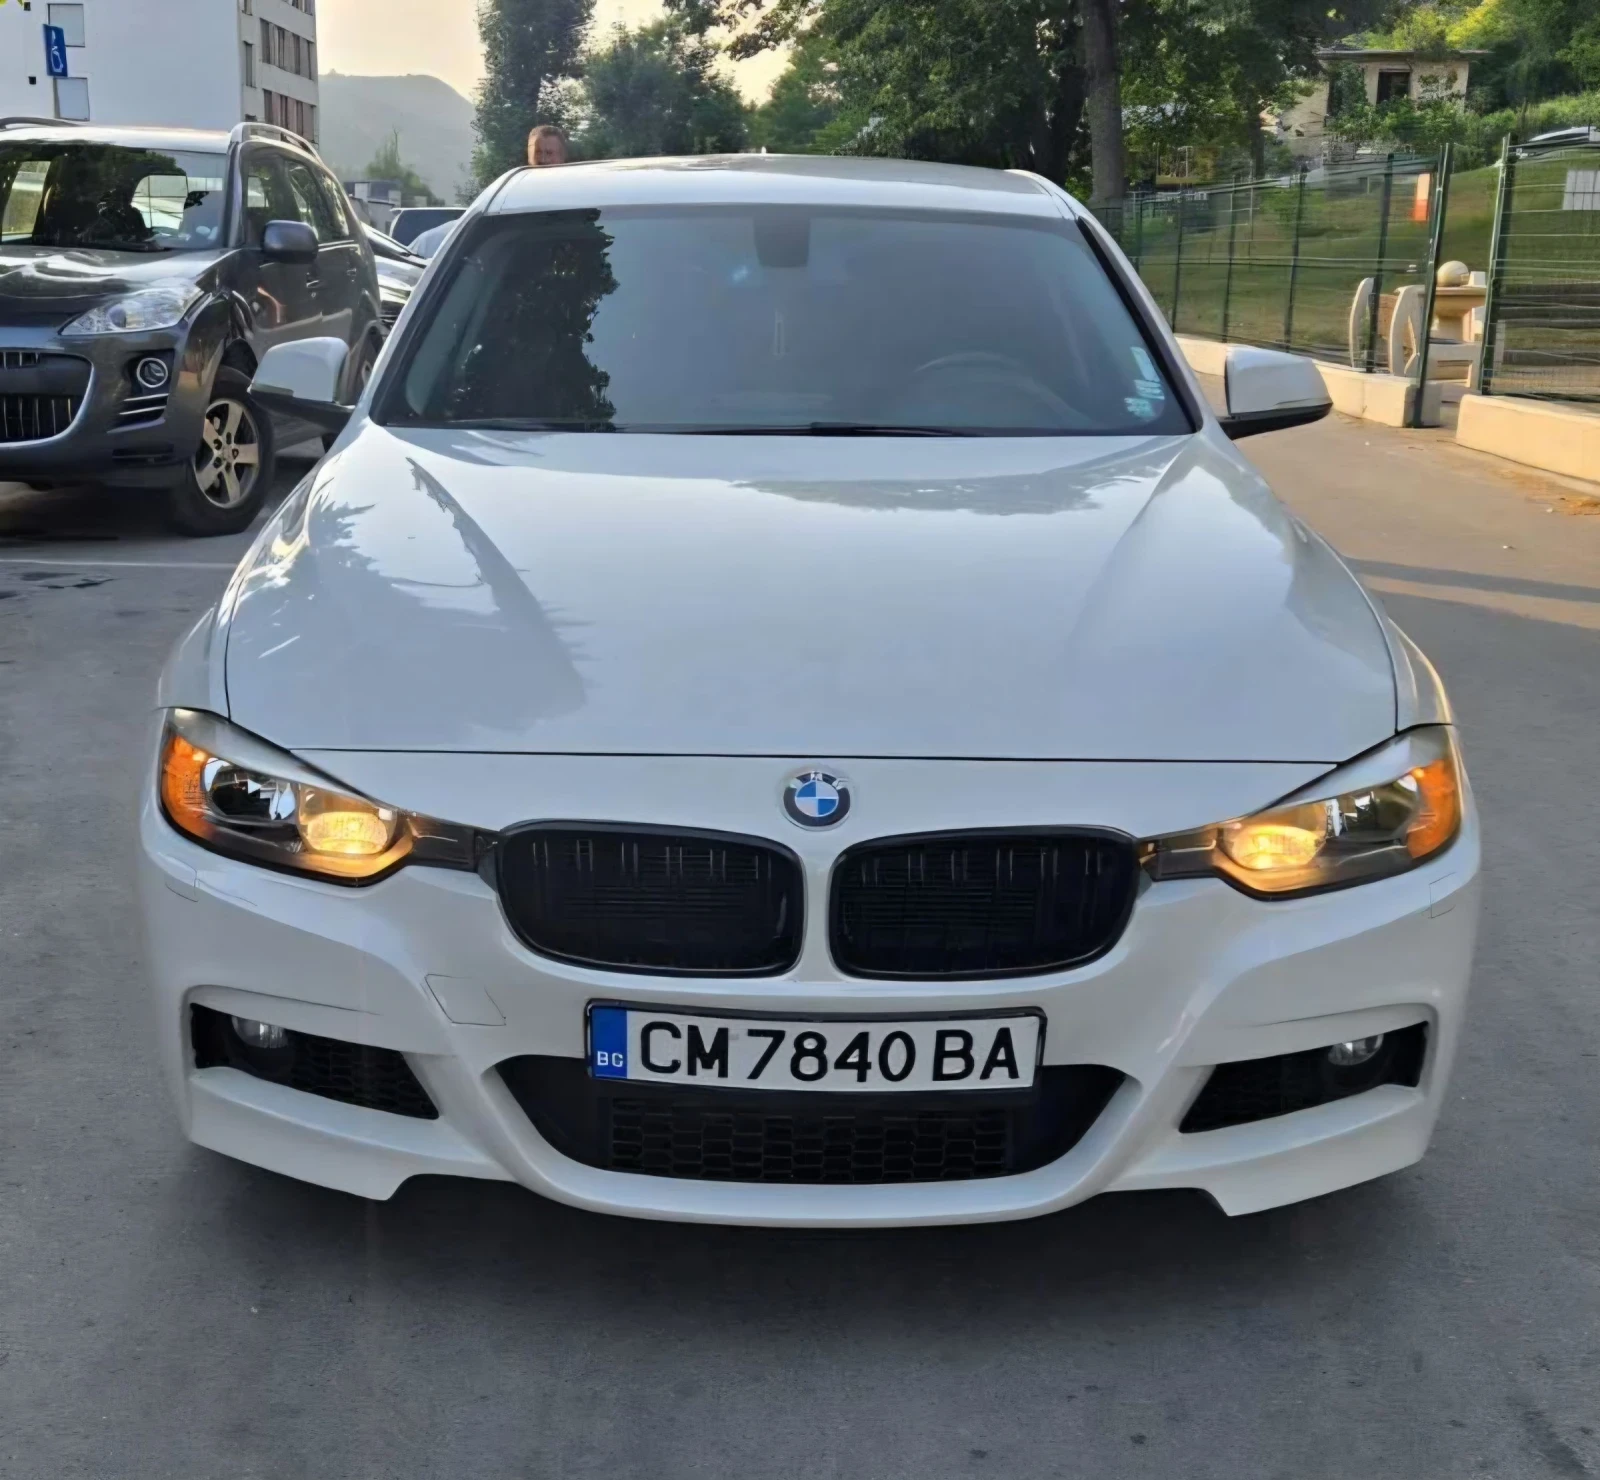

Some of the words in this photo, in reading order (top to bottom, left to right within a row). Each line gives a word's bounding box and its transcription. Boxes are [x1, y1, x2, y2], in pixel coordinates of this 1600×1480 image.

[641, 1021, 729, 1078] CM
[747, 1029, 916, 1082] 7840
[932, 1027, 1020, 1082] BA
